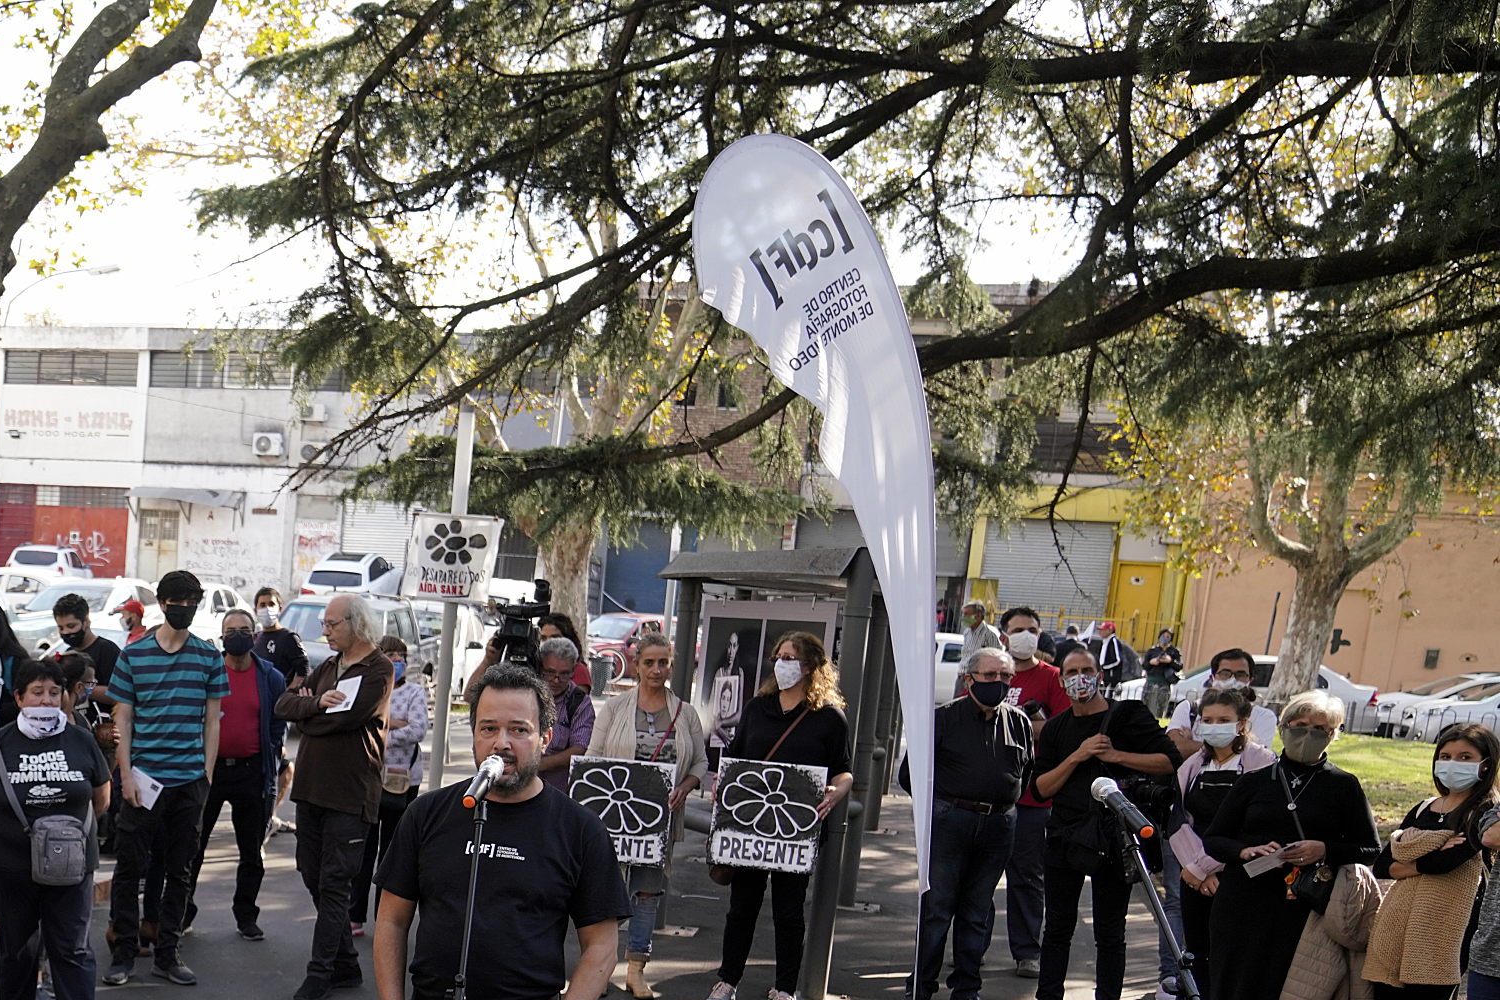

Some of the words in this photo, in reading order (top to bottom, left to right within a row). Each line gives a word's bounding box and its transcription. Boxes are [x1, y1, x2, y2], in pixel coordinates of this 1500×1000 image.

[4, 409, 58, 428] HONG
[78, 411, 133, 430] KONG
[19, 750, 66, 765] TODOS
[19, 761, 69, 772] SOMOS
[613, 836, 655, 859] ENTE
[718, 836, 810, 866] PRESENTE
